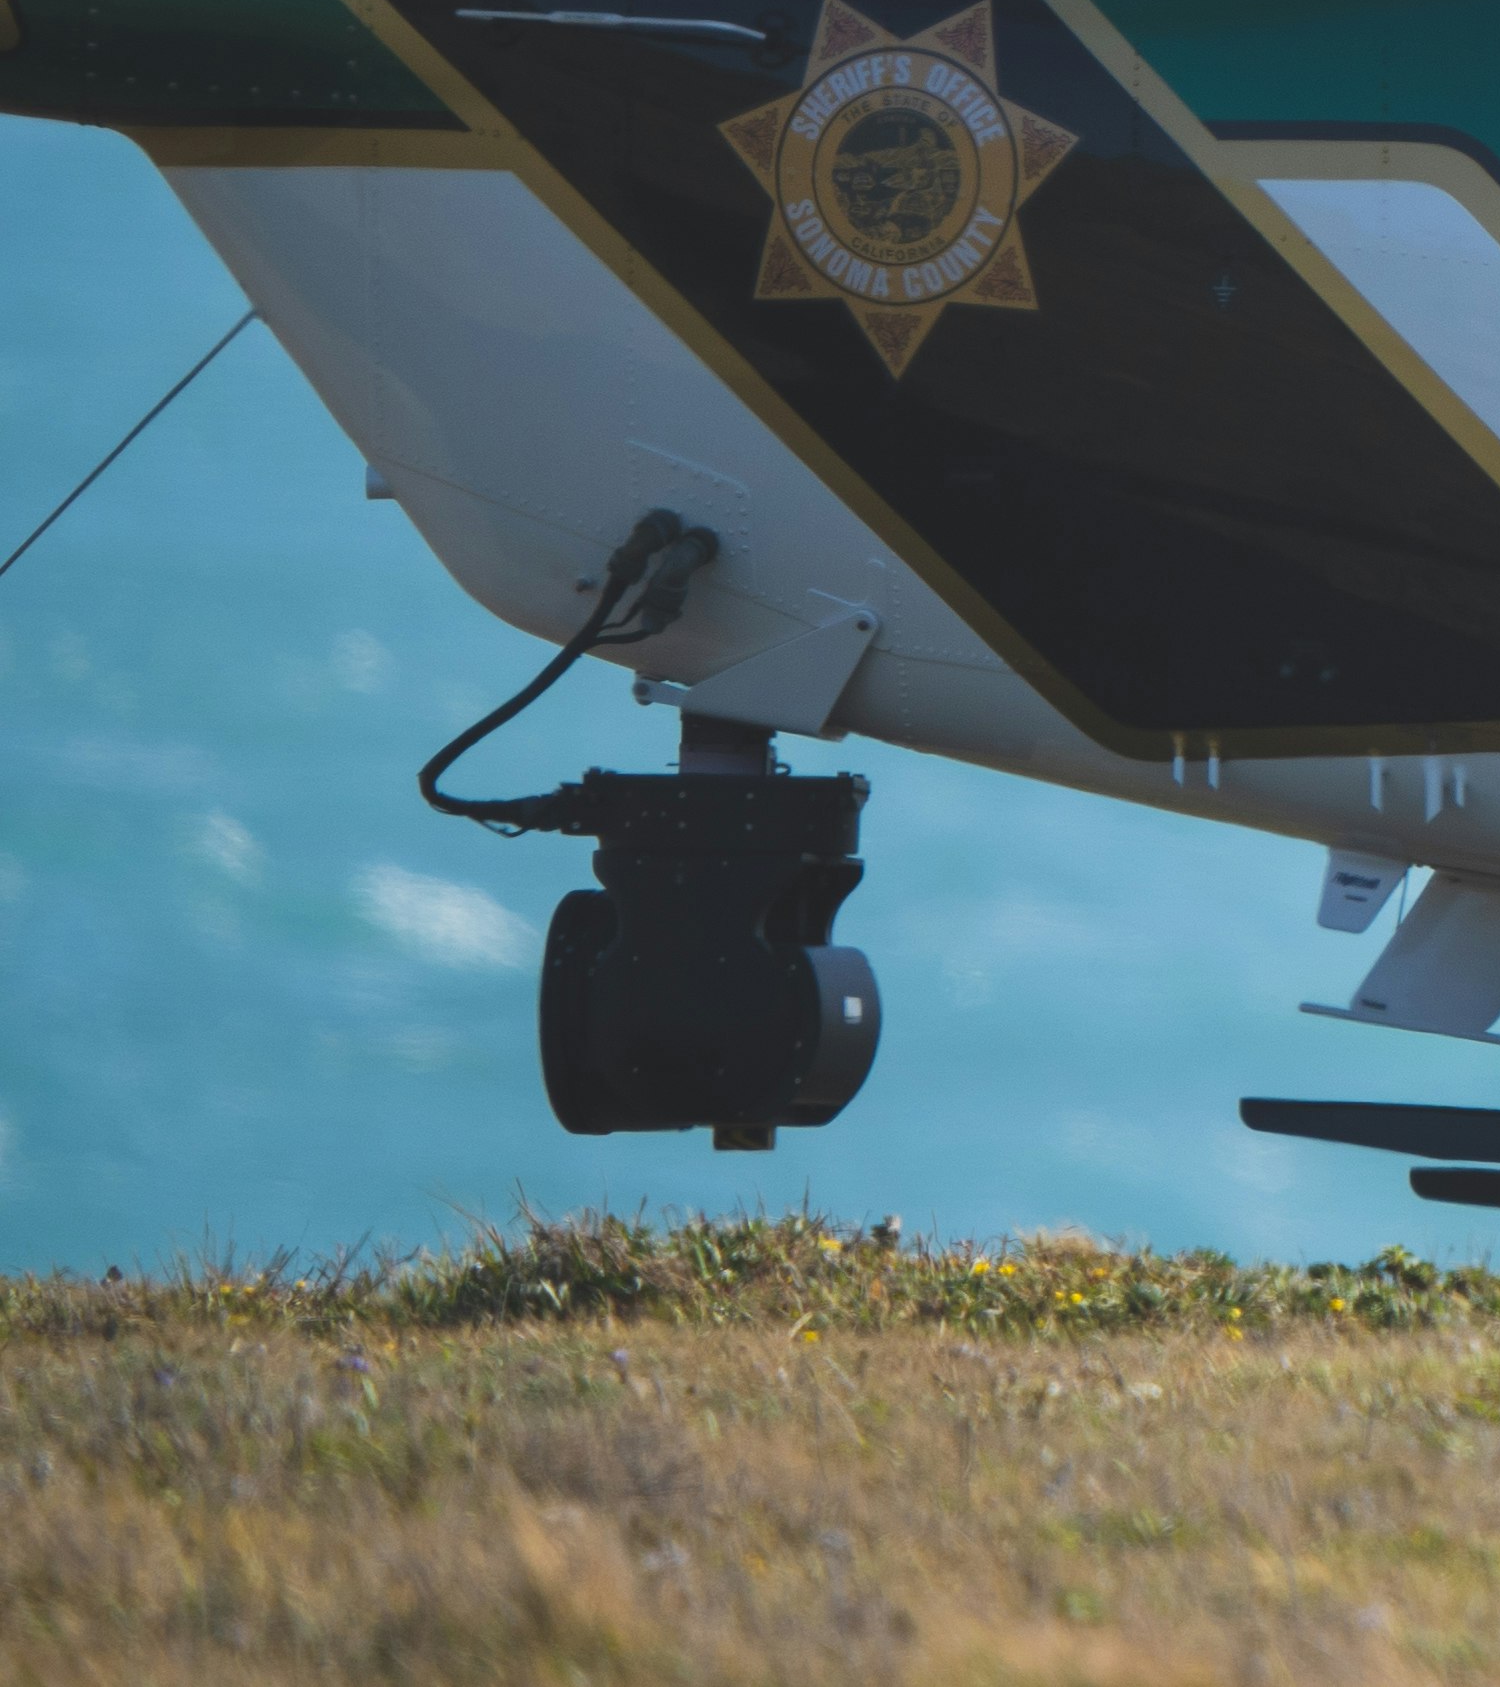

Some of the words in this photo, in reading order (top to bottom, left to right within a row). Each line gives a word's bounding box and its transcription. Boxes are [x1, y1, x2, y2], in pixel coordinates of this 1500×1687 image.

[789, 55, 912, 141] SHERIFF'S
[925, 63, 1006, 147] OFFICE
[785, 198, 890, 297] SONOMA
[902, 205, 1004, 299] COUNTY
[851, 235, 946, 260] CALIFORNIA
